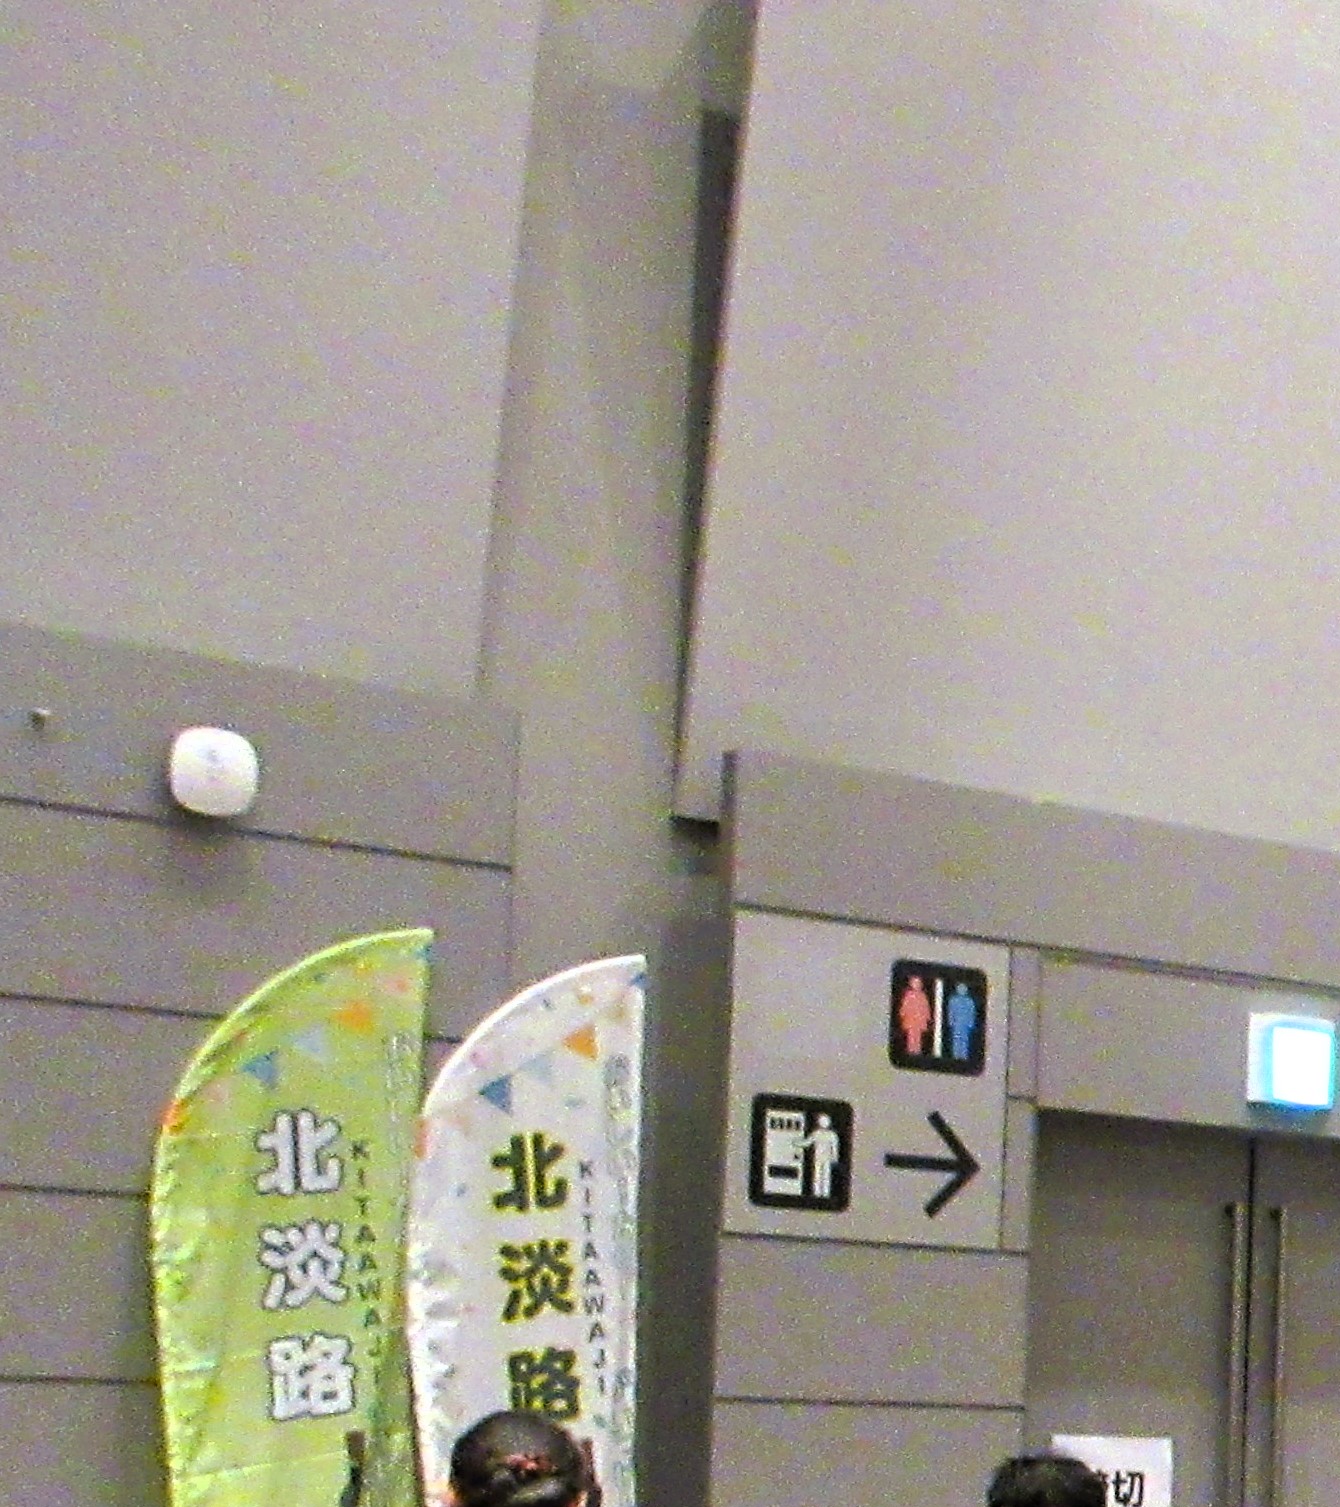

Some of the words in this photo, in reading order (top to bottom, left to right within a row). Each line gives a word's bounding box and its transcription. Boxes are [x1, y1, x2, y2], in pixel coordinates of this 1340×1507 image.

[256, 1108, 357, 1421] 北淡路
[492, 1132, 582, 1419] 北淡路
[578, 1161, 606, 1394] KITAAWAJI
